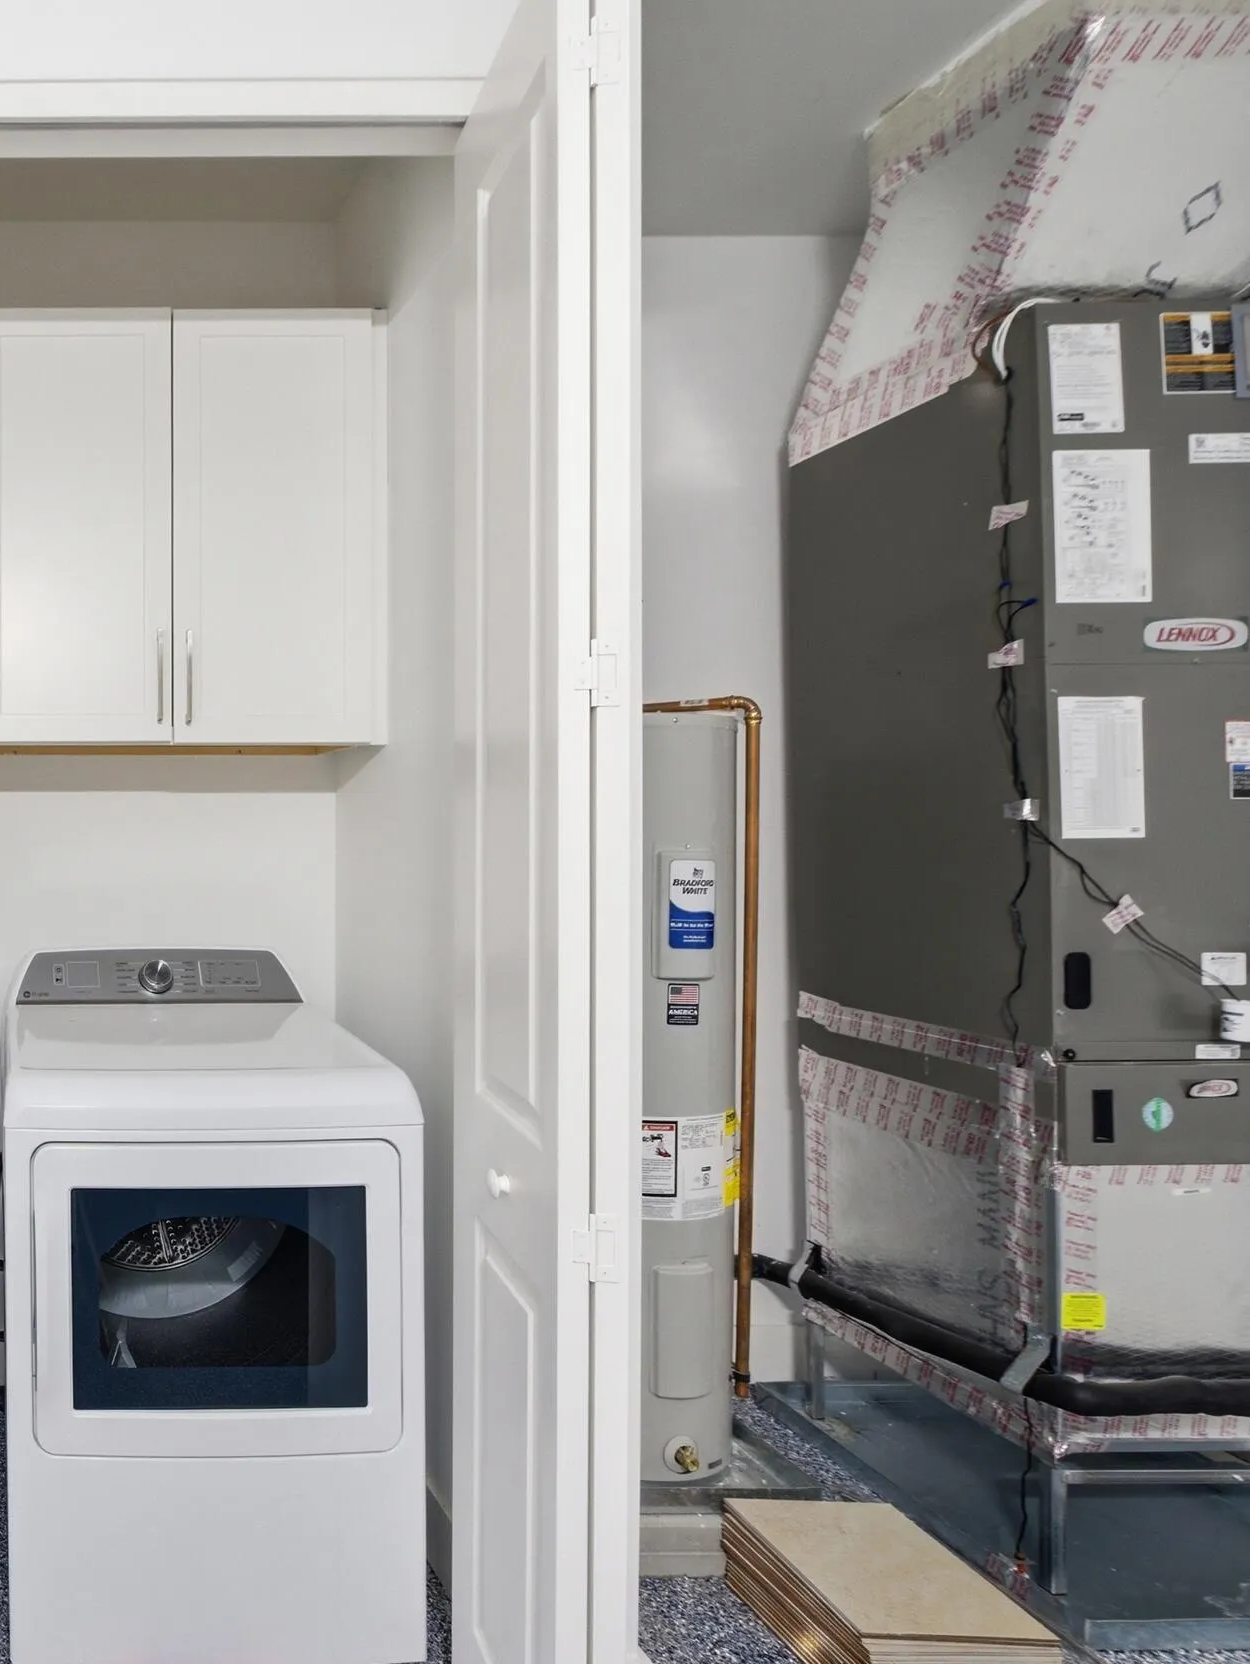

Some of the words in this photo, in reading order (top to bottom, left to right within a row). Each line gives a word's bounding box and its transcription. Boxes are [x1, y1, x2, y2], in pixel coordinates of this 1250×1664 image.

[1156, 627, 1222, 642] LENNOX
[672, 879, 715, 887] BRADFORD
[682, 887, 709, 895] WHITE
